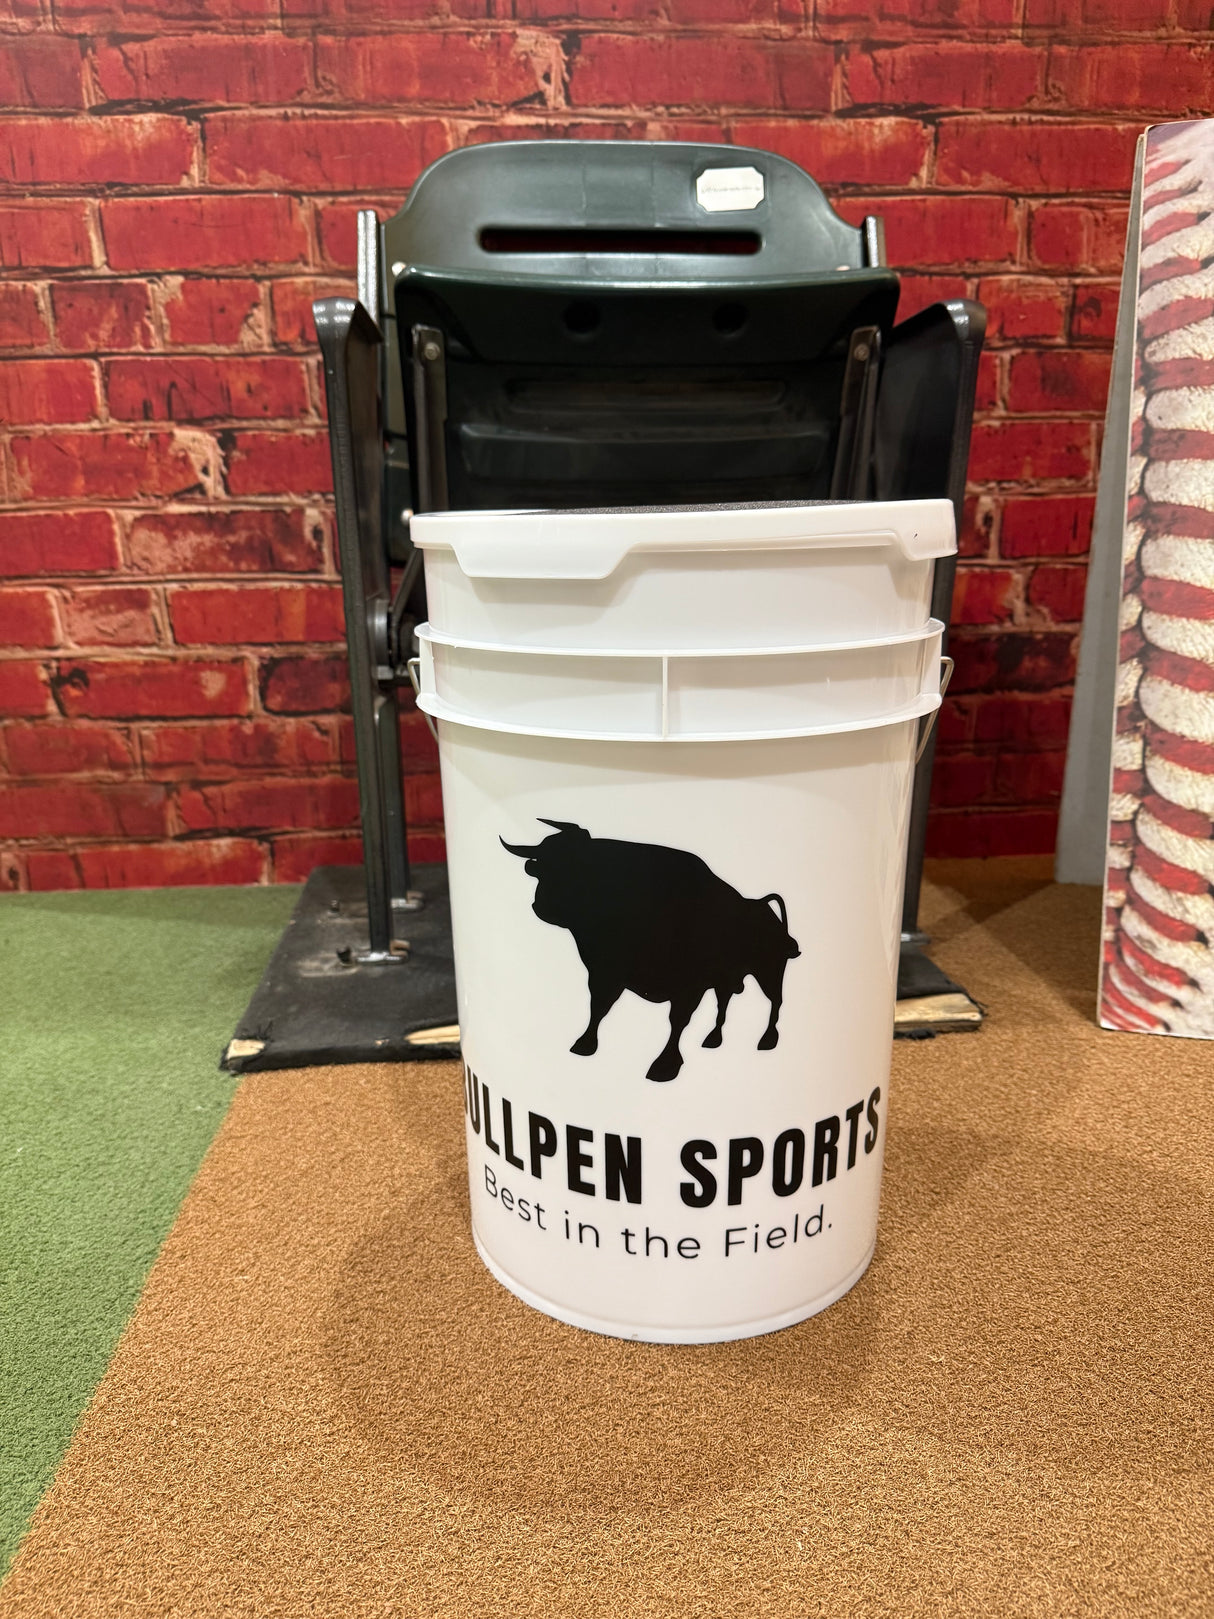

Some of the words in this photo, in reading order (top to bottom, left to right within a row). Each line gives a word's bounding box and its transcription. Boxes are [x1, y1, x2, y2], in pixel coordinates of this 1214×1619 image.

[464, 1065, 642, 1204] ULLPEN
[680, 1086, 881, 1208] SPORTS
[484, 1164, 547, 1231] Best
[564, 1211, 600, 1249] in
[621, 1226, 701, 1260] the
[725, 1204, 833, 1258] Field.
